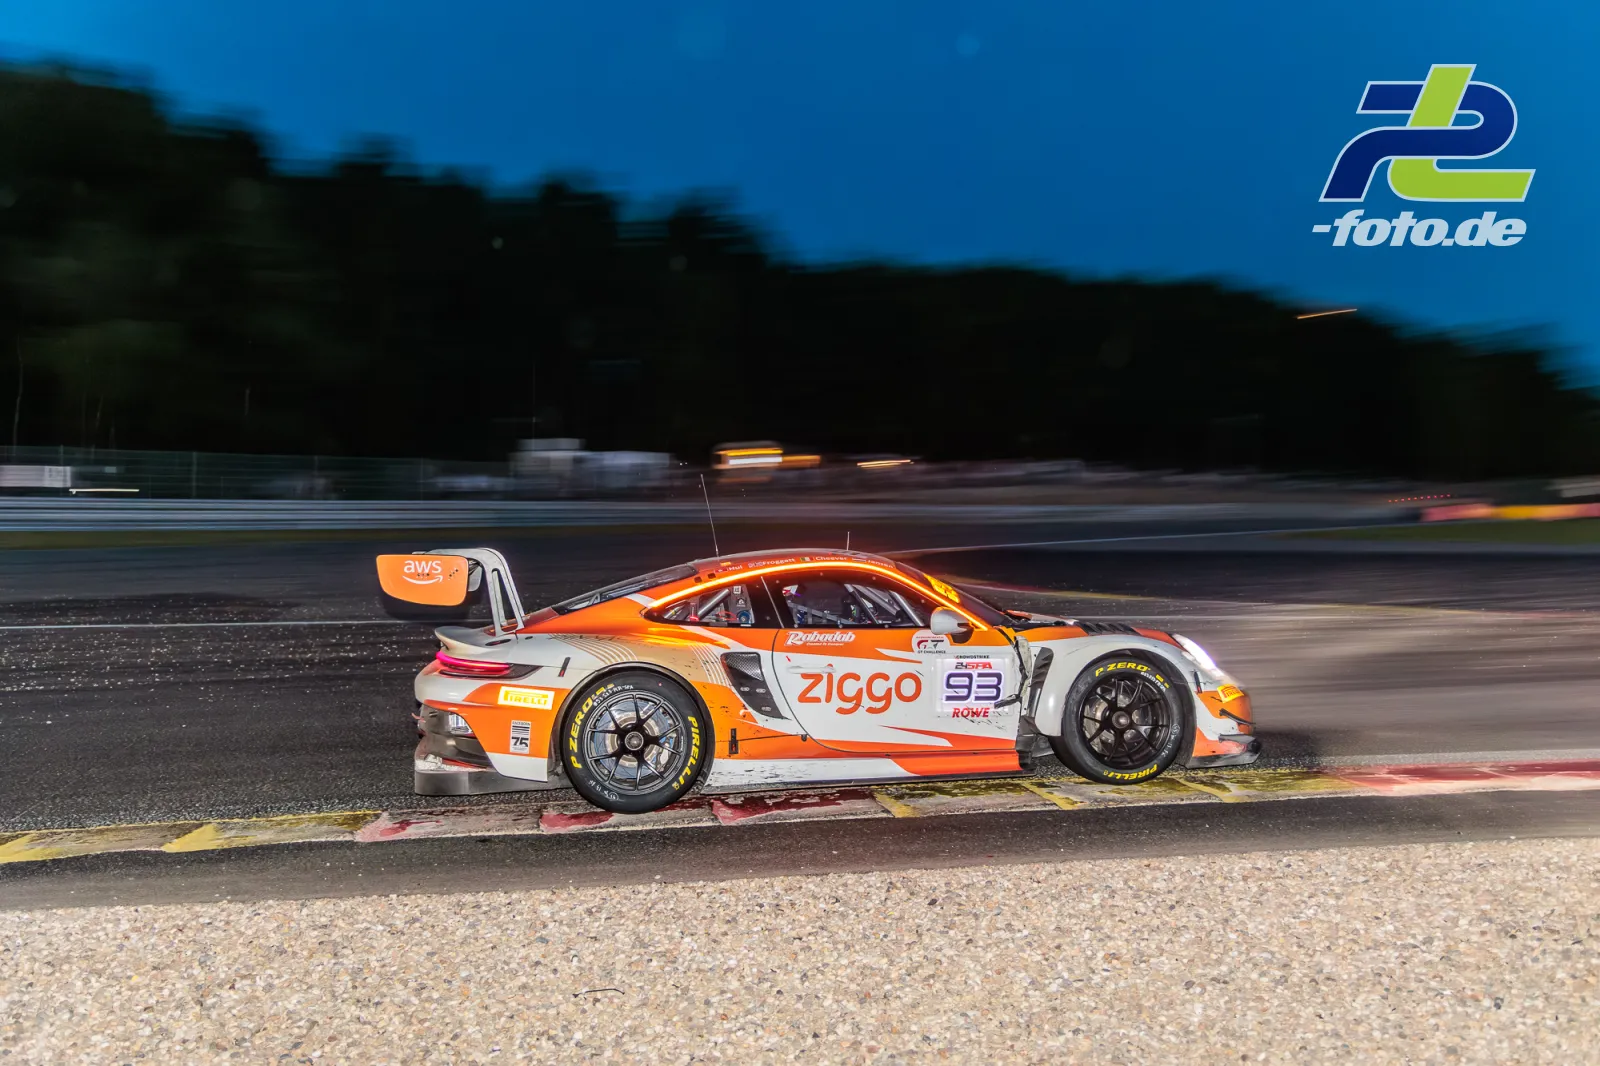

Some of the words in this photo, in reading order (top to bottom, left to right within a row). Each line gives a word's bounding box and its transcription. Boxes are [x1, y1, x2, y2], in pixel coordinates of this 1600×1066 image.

[403, 560, 442, 573] aws
[1095, 667, 1104, 677] P
[1107, 662, 1148, 672] ZERO
[797, 663, 922, 715] ziggo
[944, 672, 1003, 702] 93
[503, 690, 549, 706] PIRELLI
[952, 707, 991, 718] ROWE
[569, 697, 593, 753] ZERO
[511, 736, 529, 748] 75
[679, 716, 700, 785] PIRELLI
[571, 756, 582, 768] P
[1108, 763, 1157, 780] PIRELLI
